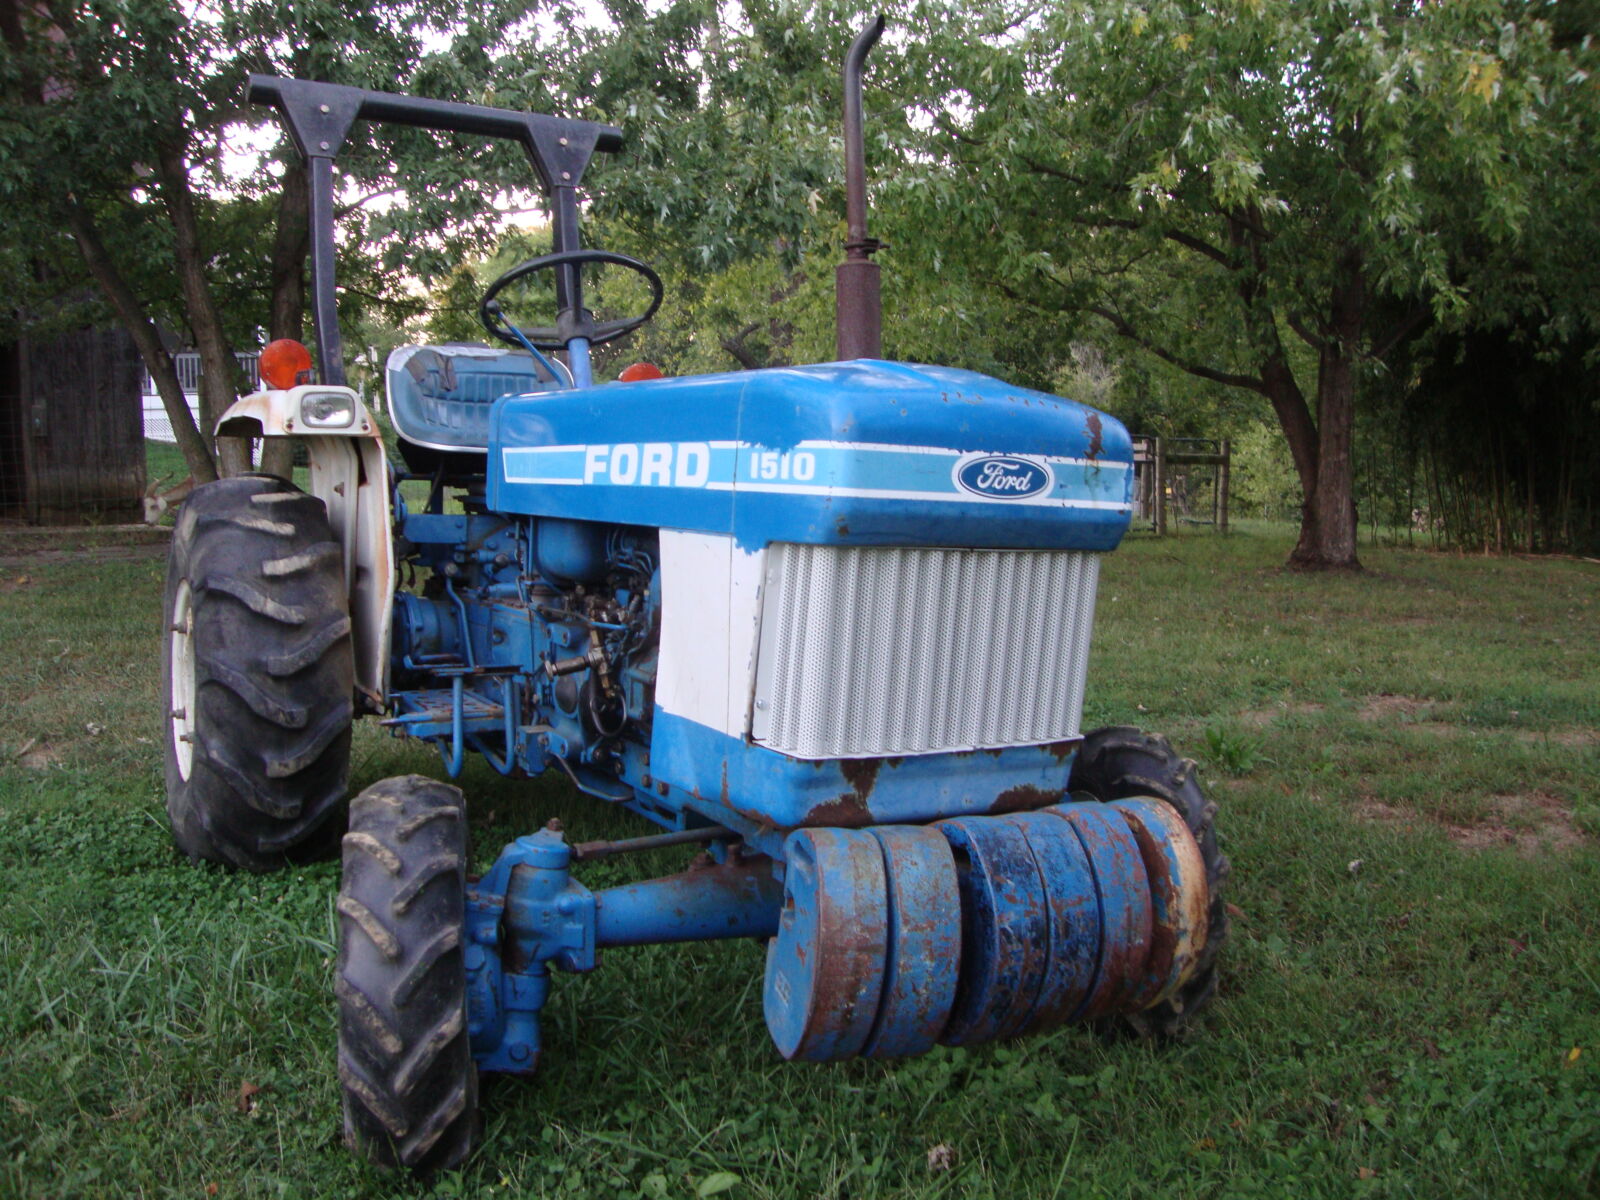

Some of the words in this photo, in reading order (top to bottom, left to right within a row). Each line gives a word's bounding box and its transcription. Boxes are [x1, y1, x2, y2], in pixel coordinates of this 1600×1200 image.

[584, 442, 711, 486] FORD
[750, 452, 815, 480] 1510
[977, 461, 1032, 491] Ford
